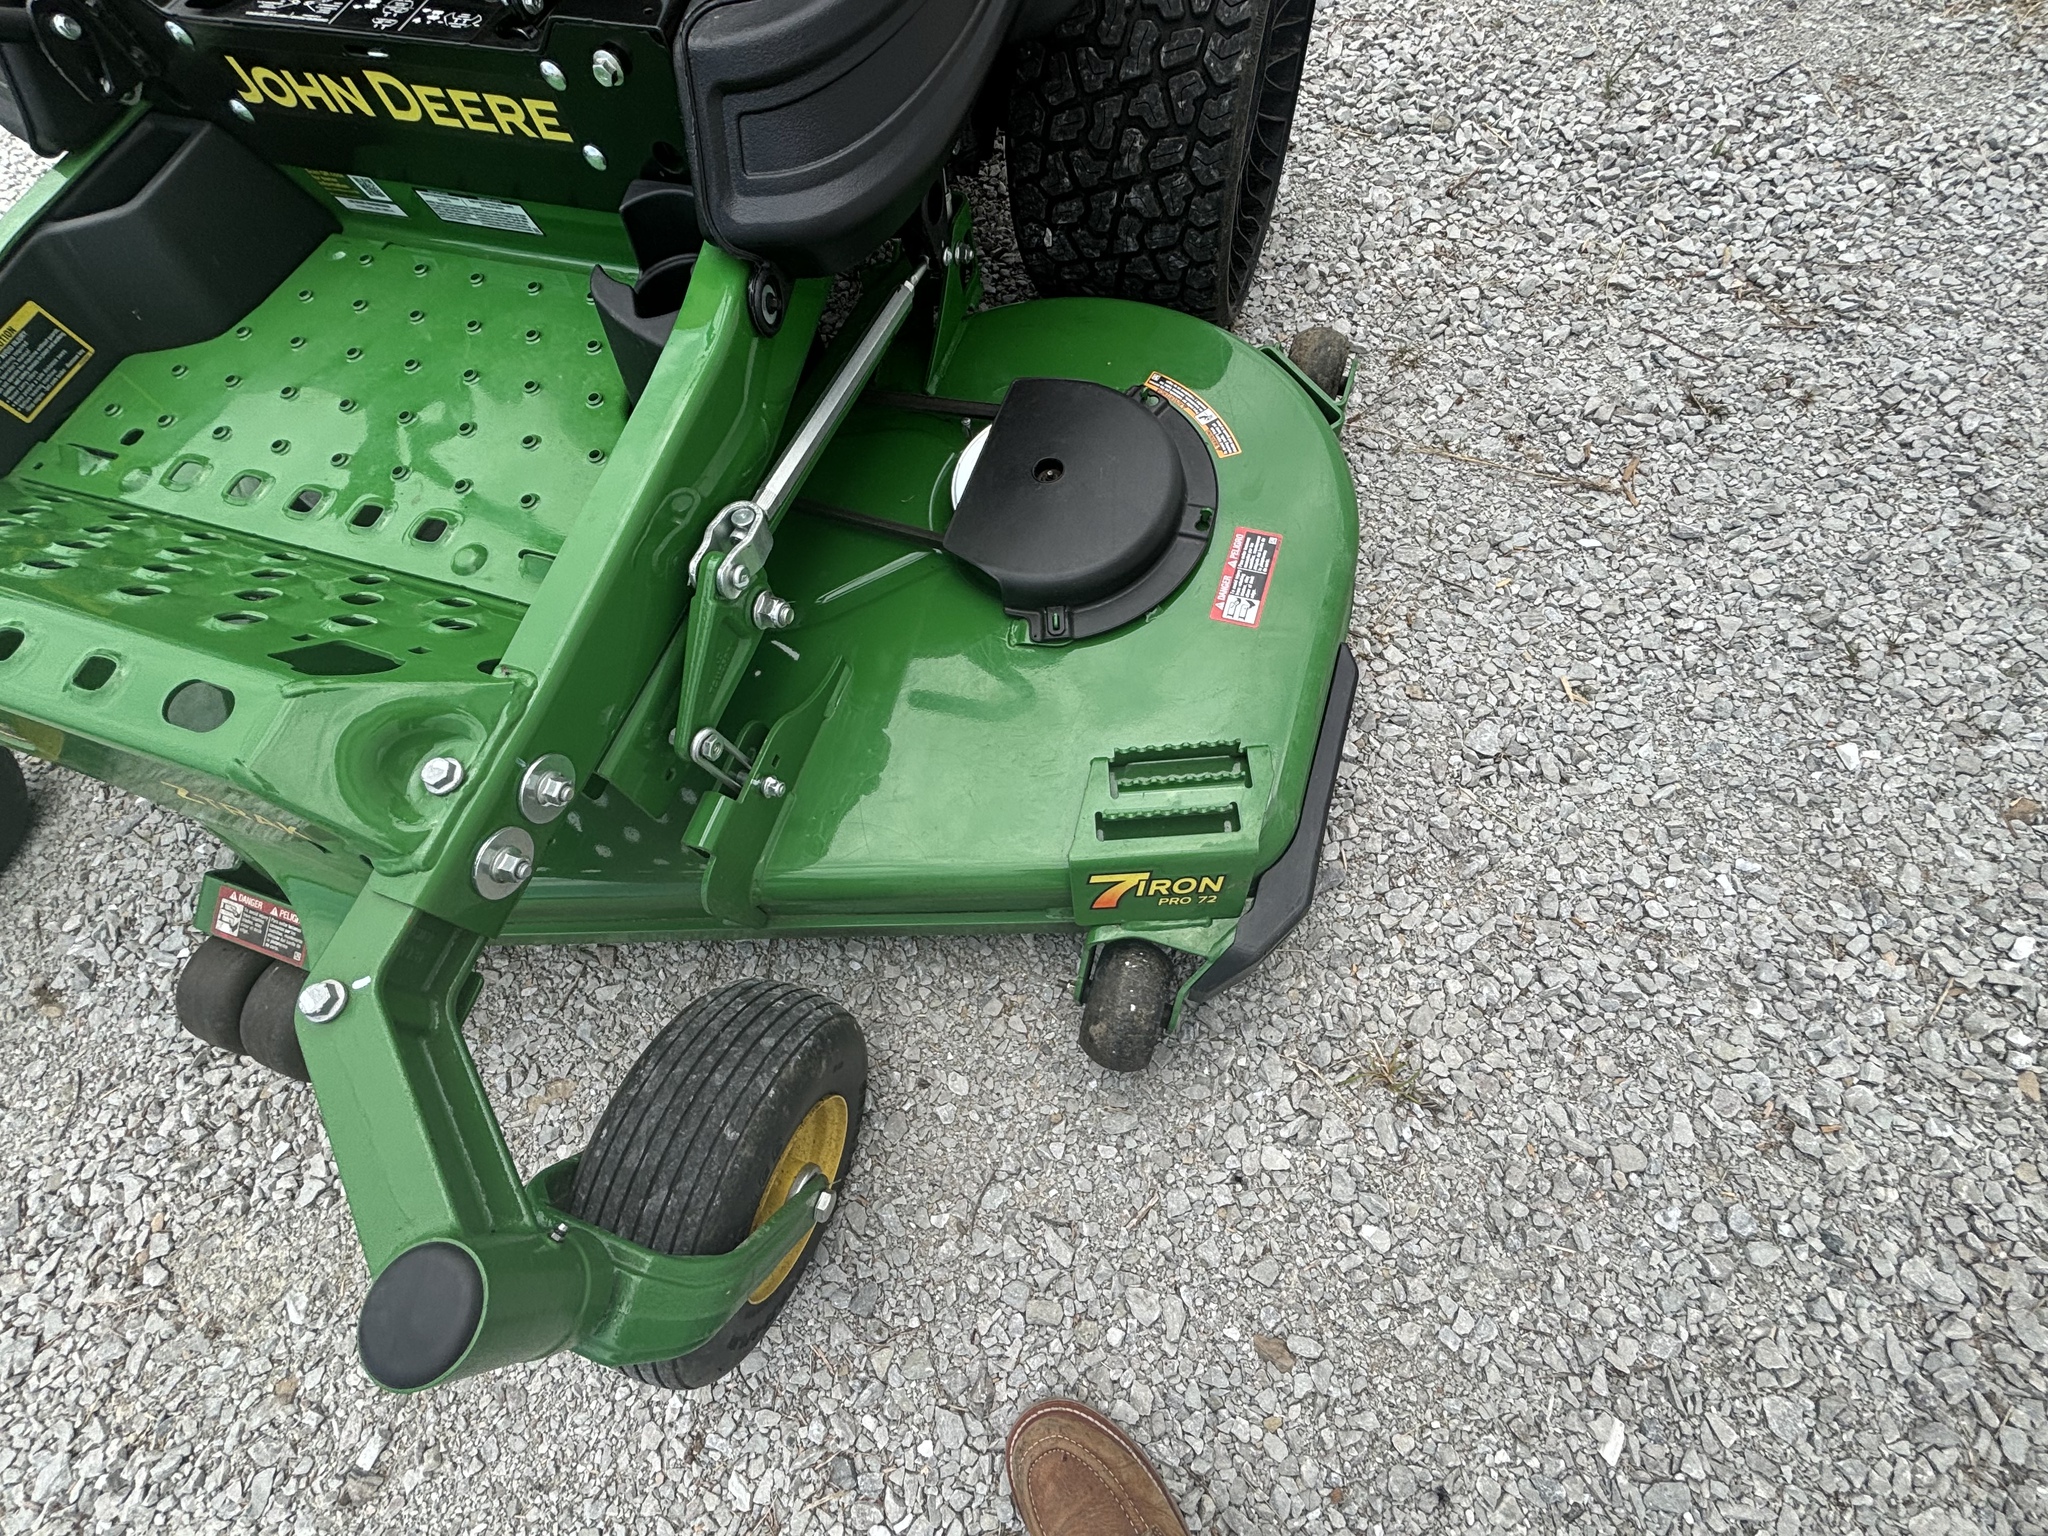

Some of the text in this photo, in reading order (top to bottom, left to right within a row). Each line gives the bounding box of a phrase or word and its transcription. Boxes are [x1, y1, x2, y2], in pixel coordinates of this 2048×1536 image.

[225, 55, 574, 143] JOHN DEERE
[1217, 575, 1232, 600] DANGER
[238, 893, 263, 910] DANGER
[1158, 895, 1218, 906] PRO 72
